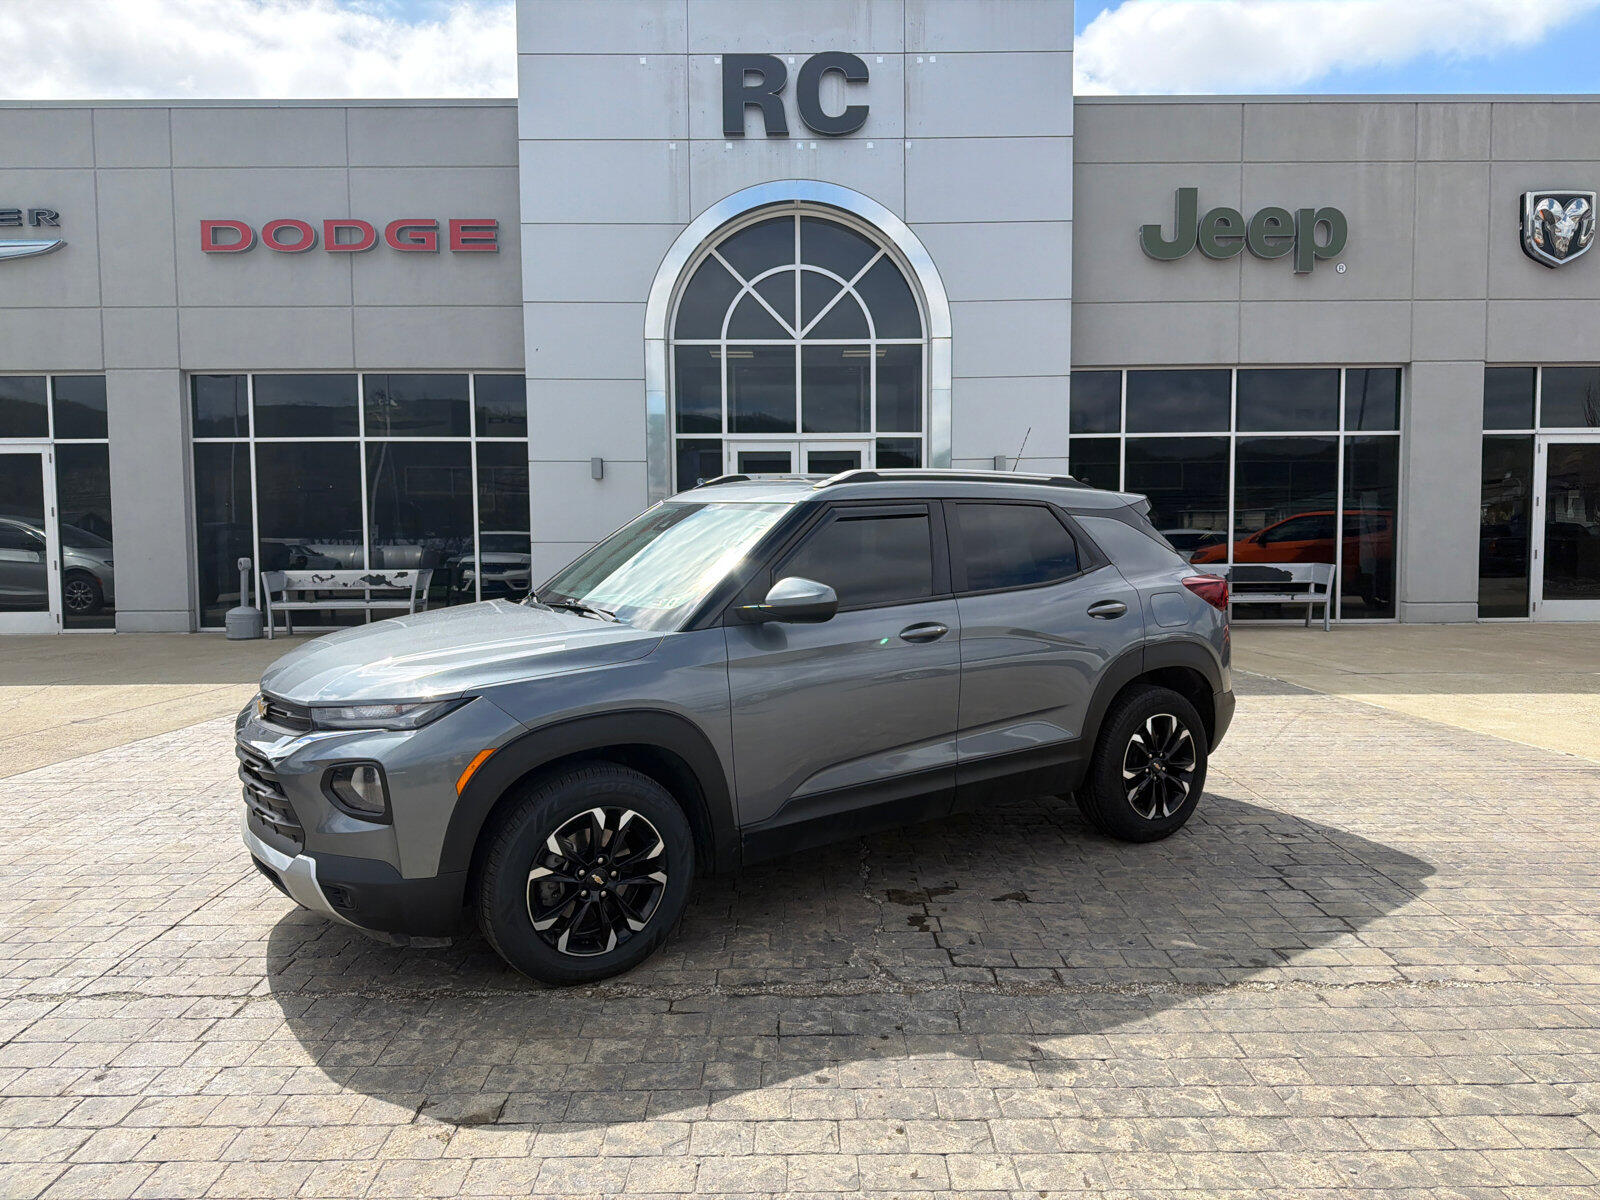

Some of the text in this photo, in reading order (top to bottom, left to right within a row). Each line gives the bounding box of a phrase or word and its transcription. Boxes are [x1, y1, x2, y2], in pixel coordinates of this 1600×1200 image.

[722, 51, 869, 137] RC
[200, 218, 499, 254] DODGE
[1139, 187, 1348, 274] Jeep
